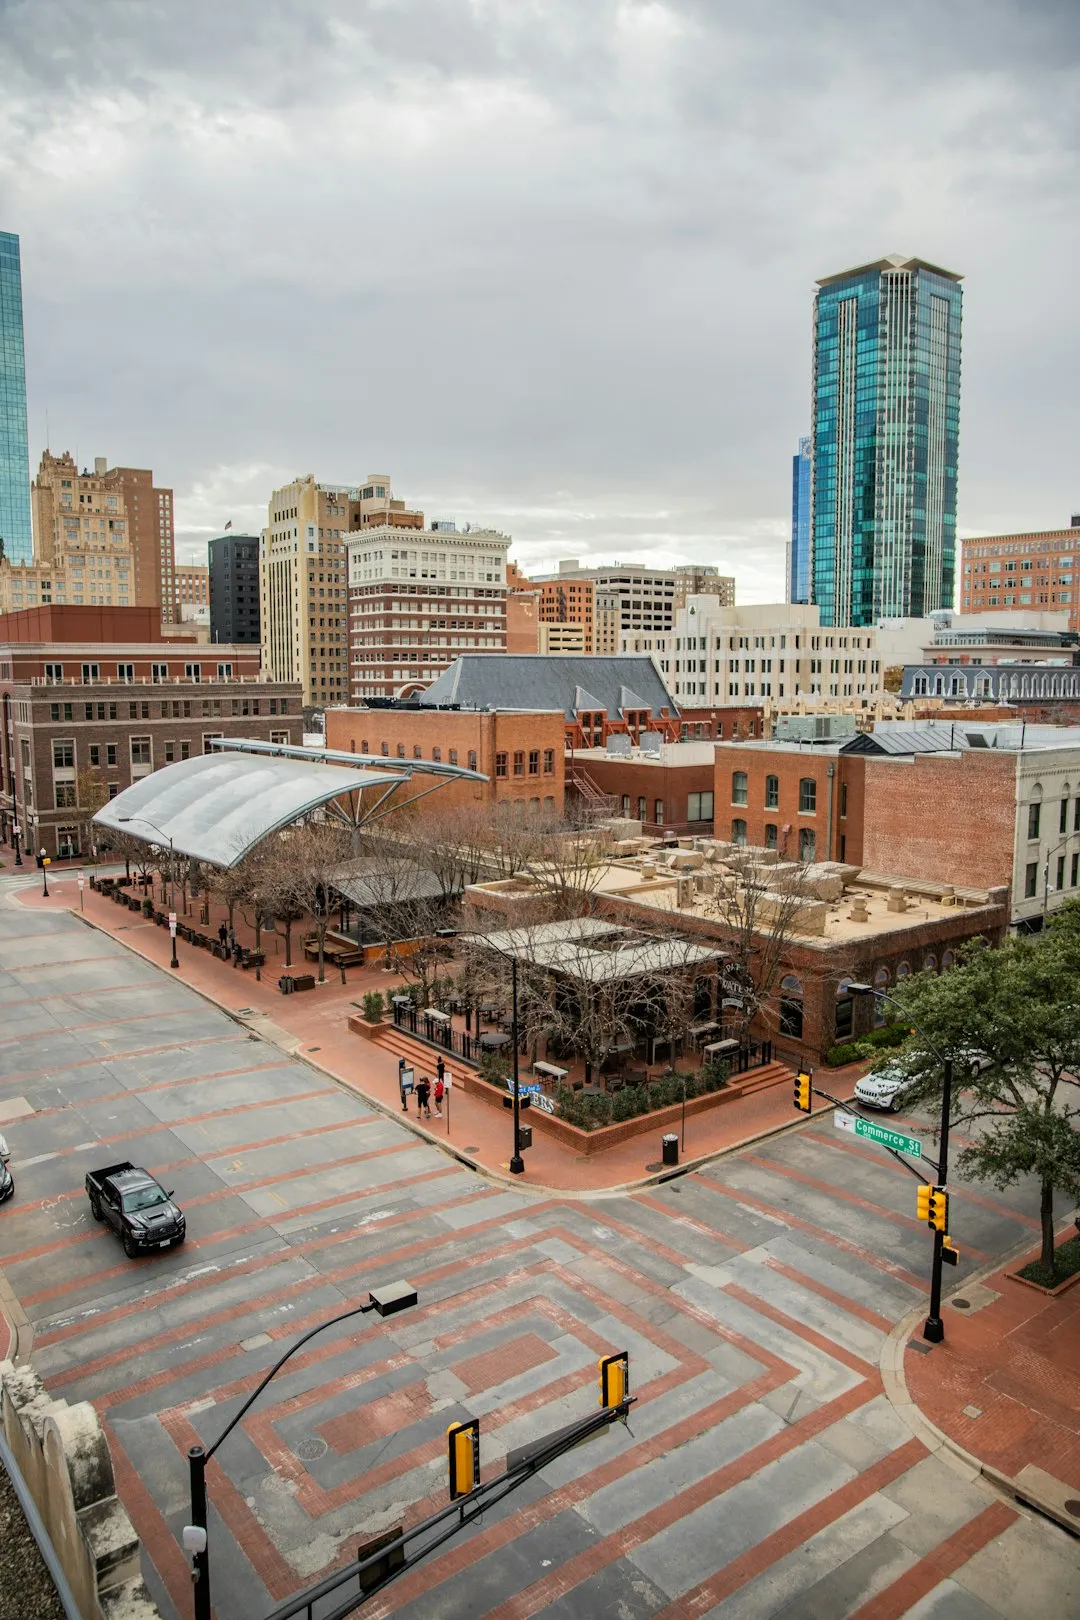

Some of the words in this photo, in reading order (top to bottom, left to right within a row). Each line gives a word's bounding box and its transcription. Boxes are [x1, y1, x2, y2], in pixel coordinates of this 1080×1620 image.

[506, 1078, 554, 1113] WERS
[856, 1120, 904, 1146] Commerce
[908, 1140, 919, 1152] St
